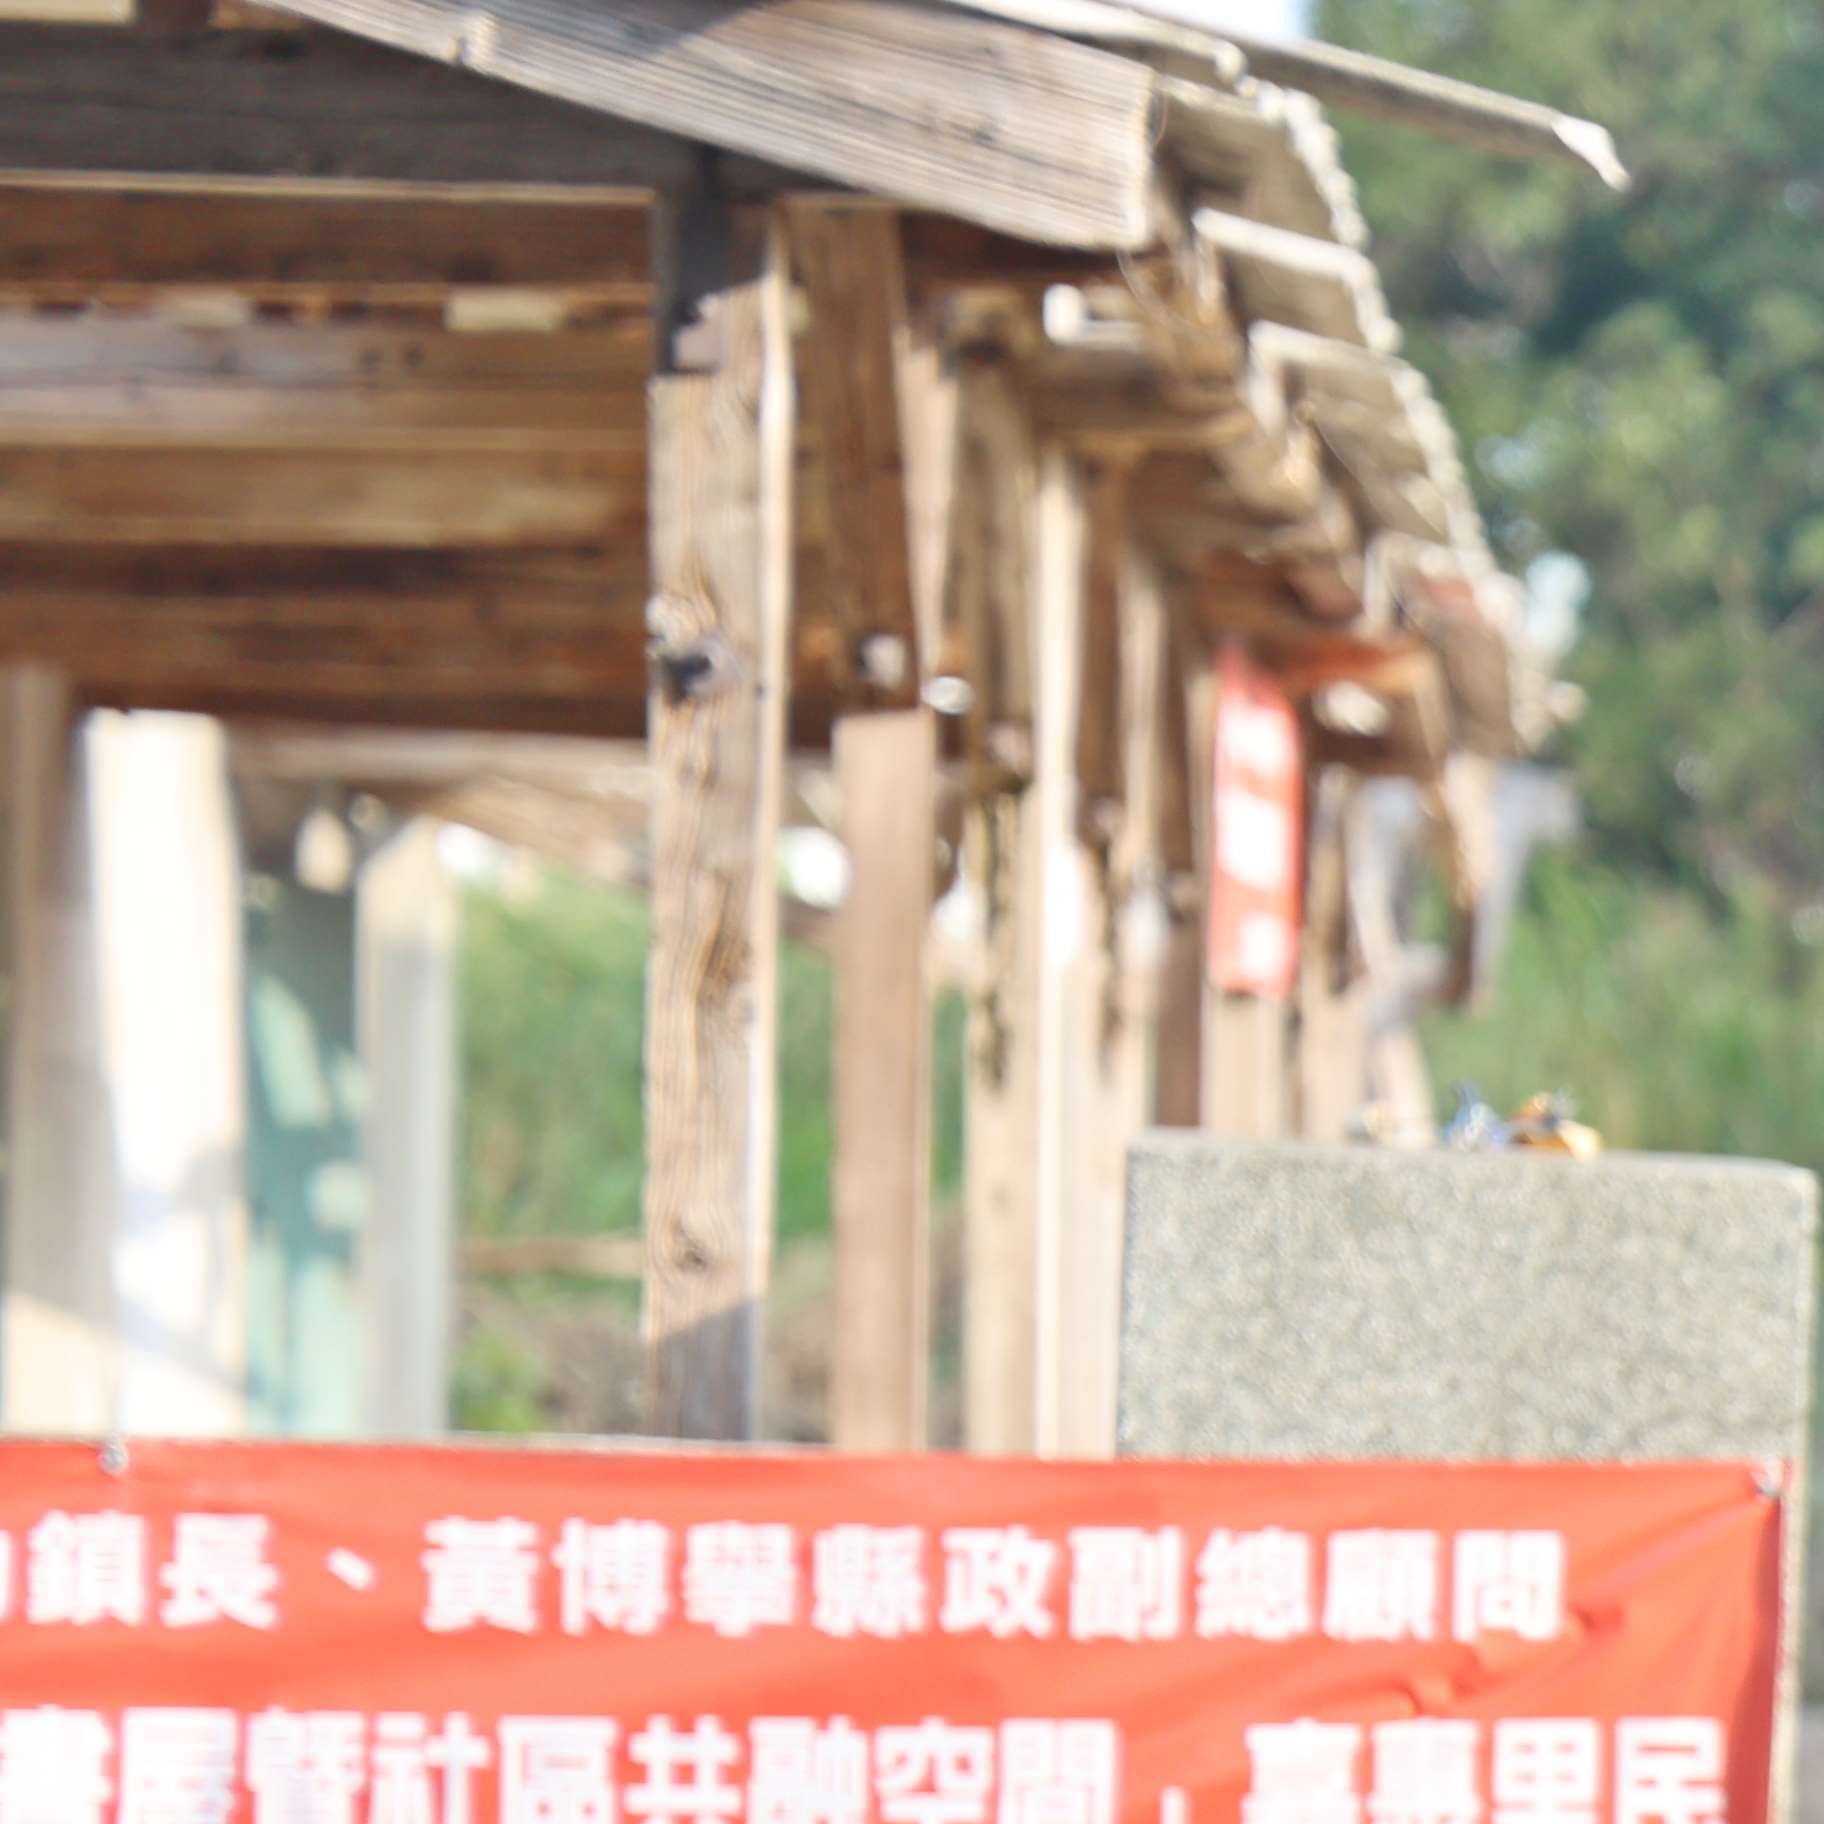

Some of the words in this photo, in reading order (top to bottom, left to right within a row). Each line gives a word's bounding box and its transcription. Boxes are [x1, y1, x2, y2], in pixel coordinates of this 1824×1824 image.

[0, 1510, 1565, 1642] 鎮長、黃博學縣政副總顧問
